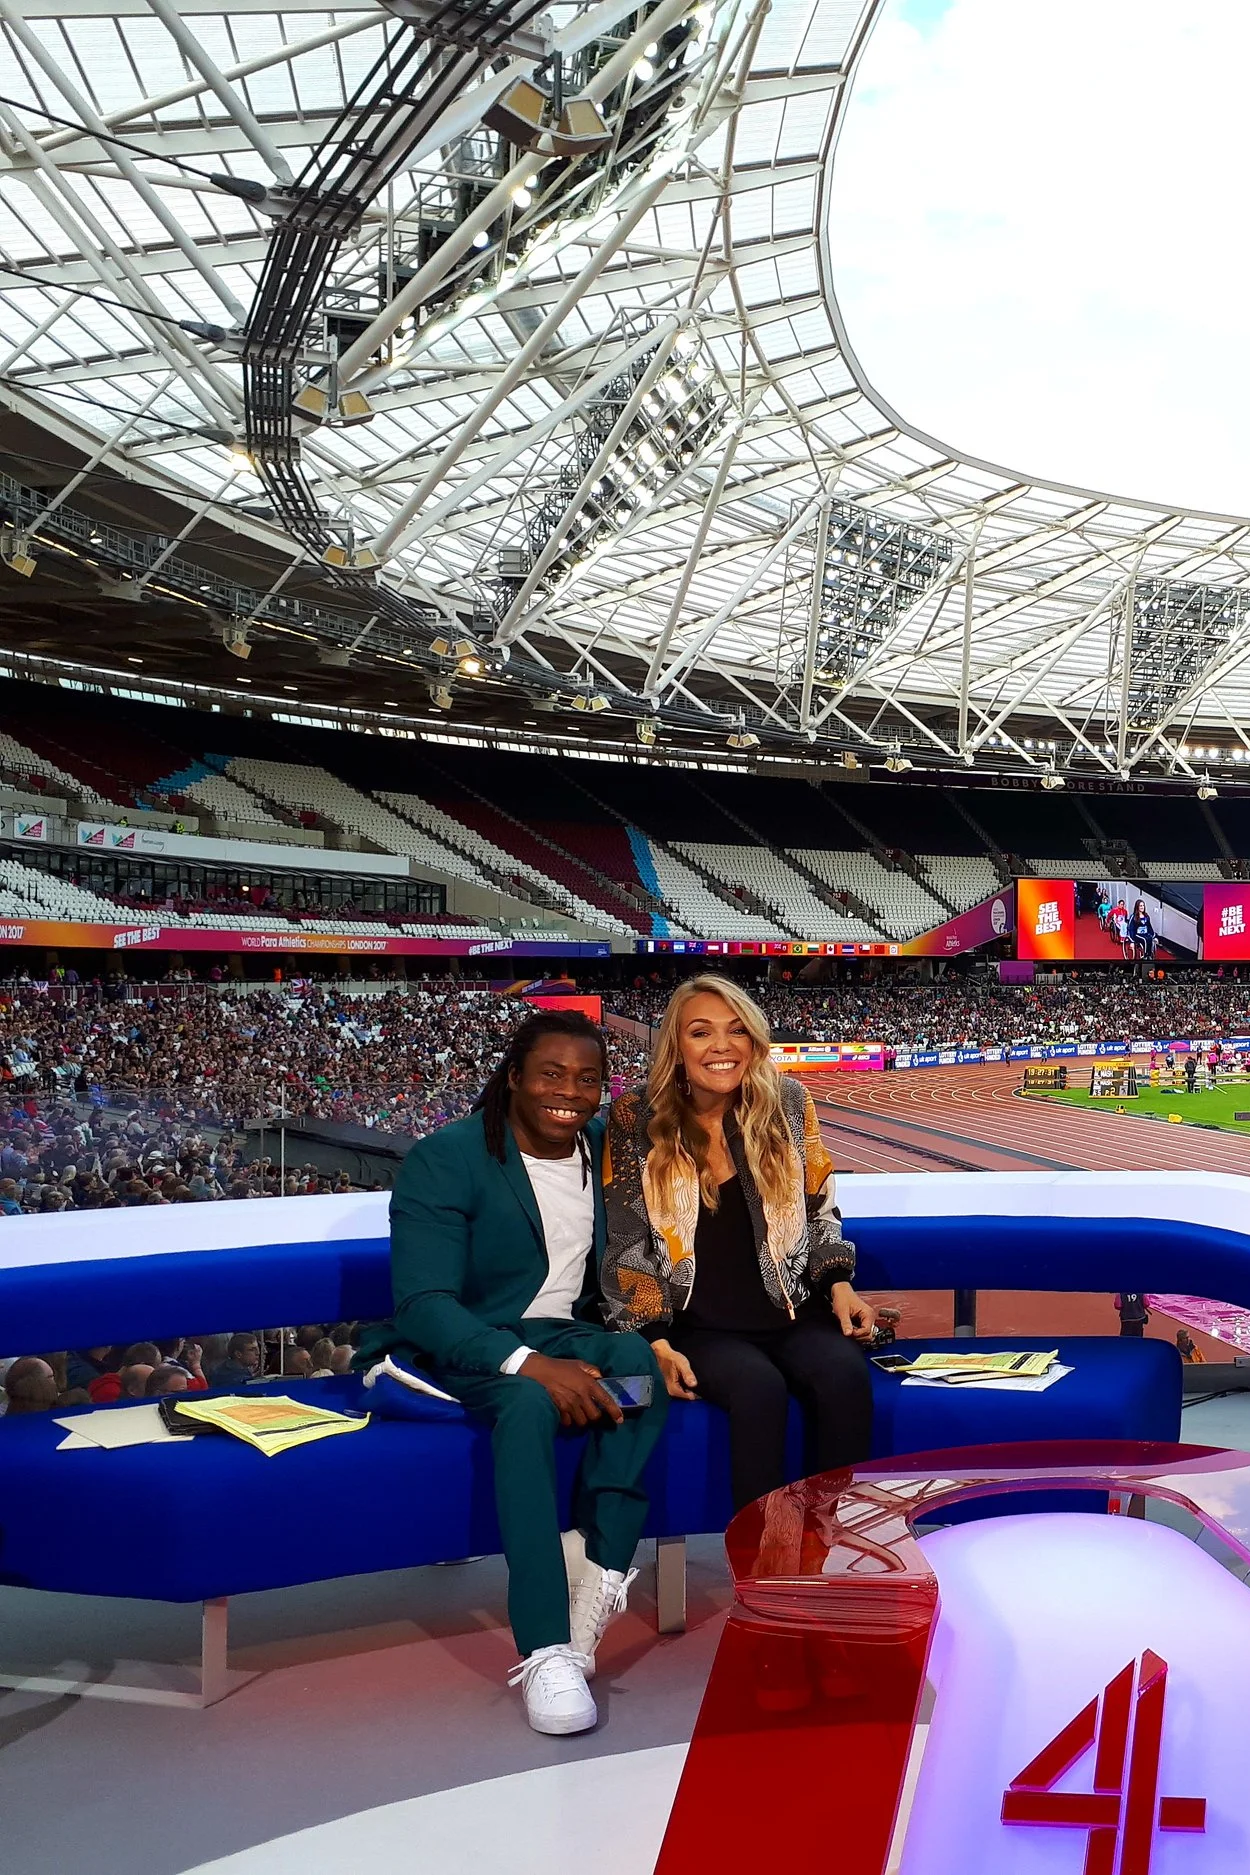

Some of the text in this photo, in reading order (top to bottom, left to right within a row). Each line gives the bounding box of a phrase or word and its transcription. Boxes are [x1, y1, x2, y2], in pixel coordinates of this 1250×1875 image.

[991, 777, 1145, 792] BOBBY ORE STAND
[1038, 901, 1058, 914] SEE
[1221, 905, 1243, 918] #BE
[1038, 911, 1059, 923] THE
[1221, 915, 1243, 927] THE
[8, 925, 24, 938] 2017
[1035, 920, 1062, 935] BEST
[1219, 924, 1246, 936] NEXT
[114, 927, 160, 948] SEE THE BEST
[241, 936, 387, 950] WORLD Para Athletics CHAMPIONSHIPS LONDON 2017
[469, 940, 514, 955] #BE THE NEXT
[1127, 1294, 1137, 1302] 19
[1000, 1648, 1207, 1875] 4
